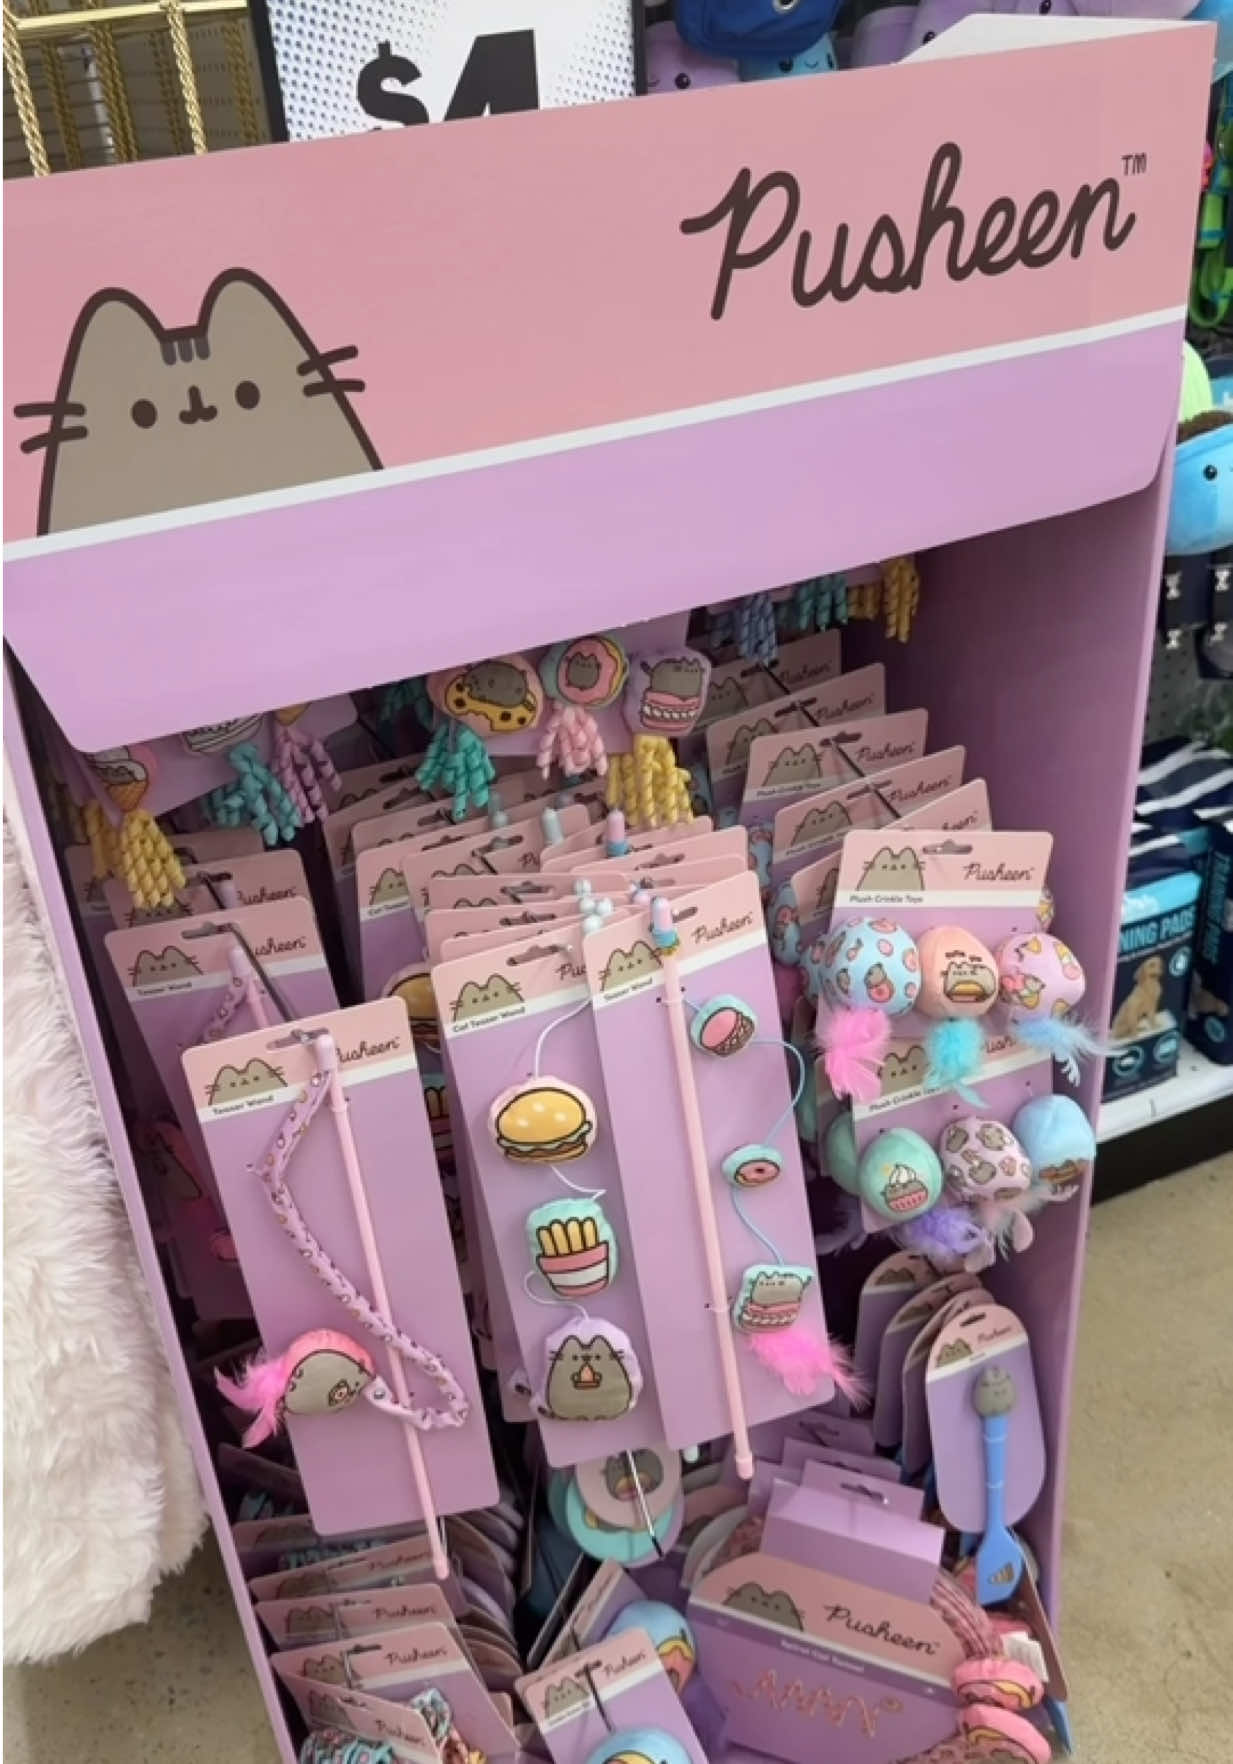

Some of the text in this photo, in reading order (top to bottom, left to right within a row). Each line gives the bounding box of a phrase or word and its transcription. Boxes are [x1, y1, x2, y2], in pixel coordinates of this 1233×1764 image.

[357, 28, 540, 130] $4
[680, 142, 1136, 320] Pusheen
[962, 862, 1035, 882] Pusheen
[691, 912, 753, 943] Pusheen
[1120, 921, 1158, 953] NING
[255, 937, 307, 957] usheen
[453, 1021, 469, 1033] Cat
[470, 1013, 499, 1029] Teaser
[823, 1602, 941, 1656] Pusheen
